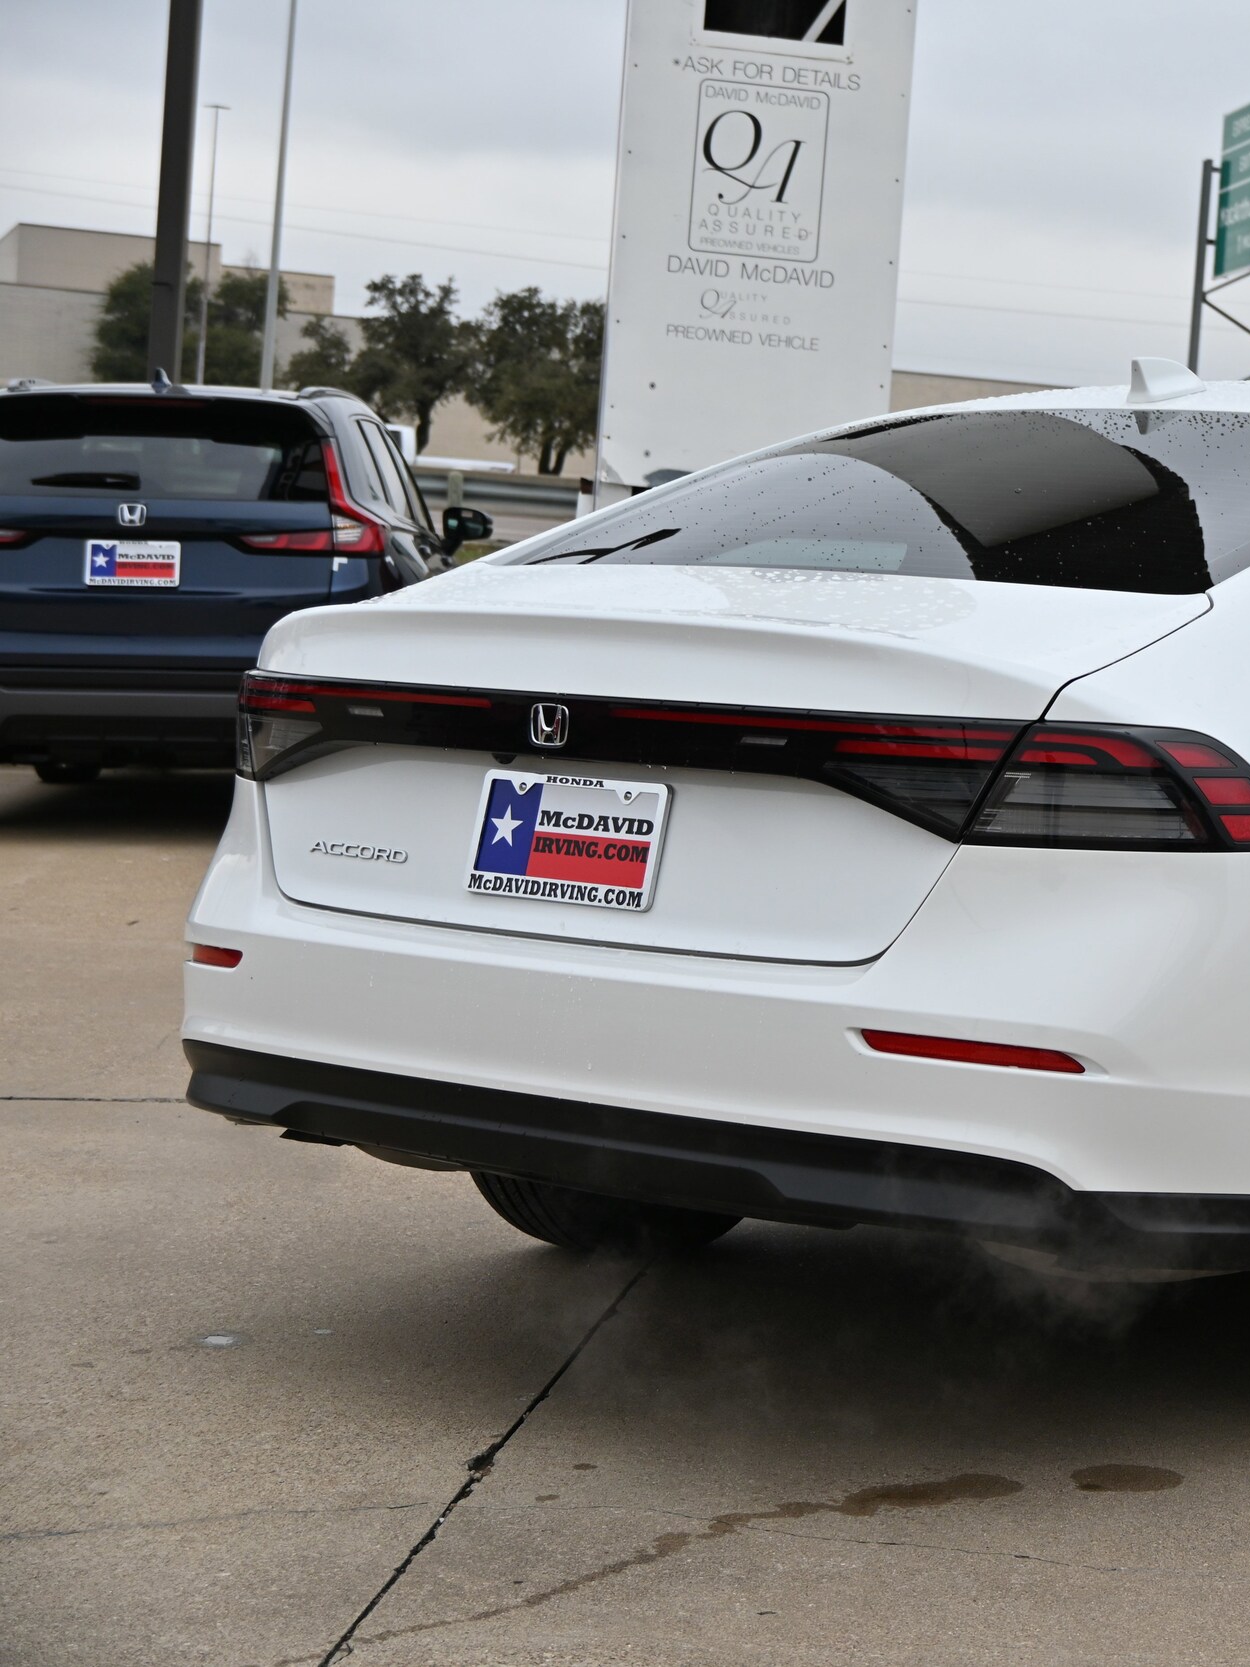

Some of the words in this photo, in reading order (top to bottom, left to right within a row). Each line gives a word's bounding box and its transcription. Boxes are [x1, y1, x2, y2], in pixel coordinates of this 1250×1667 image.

[731, 60, 774, 81] FOR
[781, 66, 861, 91] DETAILS
[704, 85, 749, 102] DAVID
[755, 90, 821, 110] McDAVID
[707, 203, 801, 224] QUALITY
[699, 218, 809, 241] ASSURED
[700, 236, 753, 250] PREOWNED
[756, 242, 800, 255] VEHICLES
[667, 255, 730, 278] DAVID
[740, 262, 835, 288] McDAVID
[666, 323, 752, 345] PREOWNED
[759, 332, 820, 351] VEHICLE
[118, 553, 175, 561] McDAVID
[89, 578, 176, 586] McDAVIDIRVING.COM
[545, 775, 605, 788] HONDA
[538, 810, 655, 836] McDAVID
[309, 839, 409, 864] ACCORD
[533, 836, 650, 864] IRVING.COM
[467, 873, 643, 908] McDAVIDIRVING.COM
